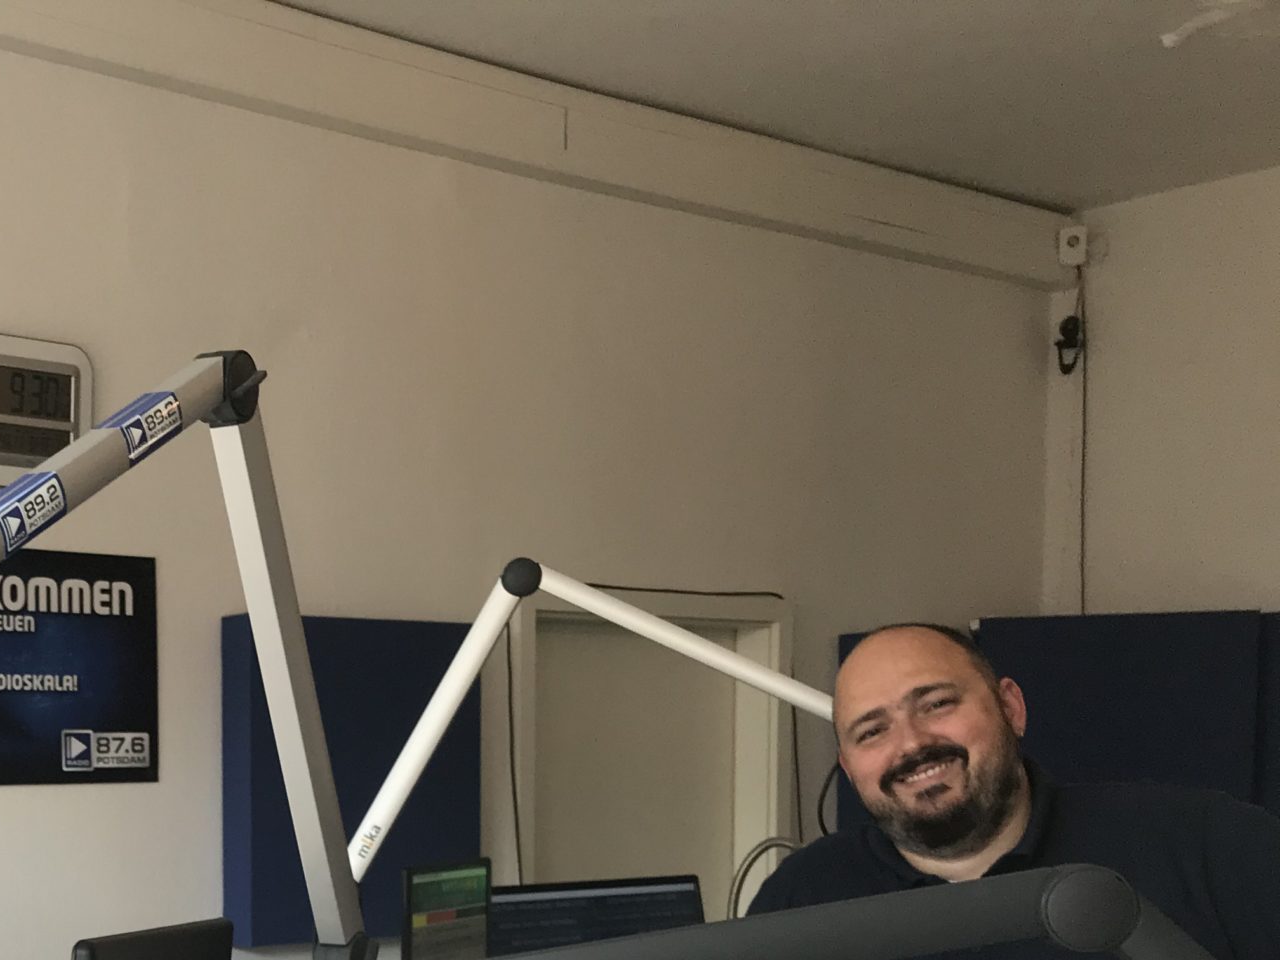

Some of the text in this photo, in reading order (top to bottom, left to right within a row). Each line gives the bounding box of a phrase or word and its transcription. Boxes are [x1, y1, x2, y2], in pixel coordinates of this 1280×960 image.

[144, 400, 178, 431] 89.2
[23, 484, 60, 520] 89.2
[96, 736, 145, 754] 87.6
[96, 755, 147, 765] POTSDAM
